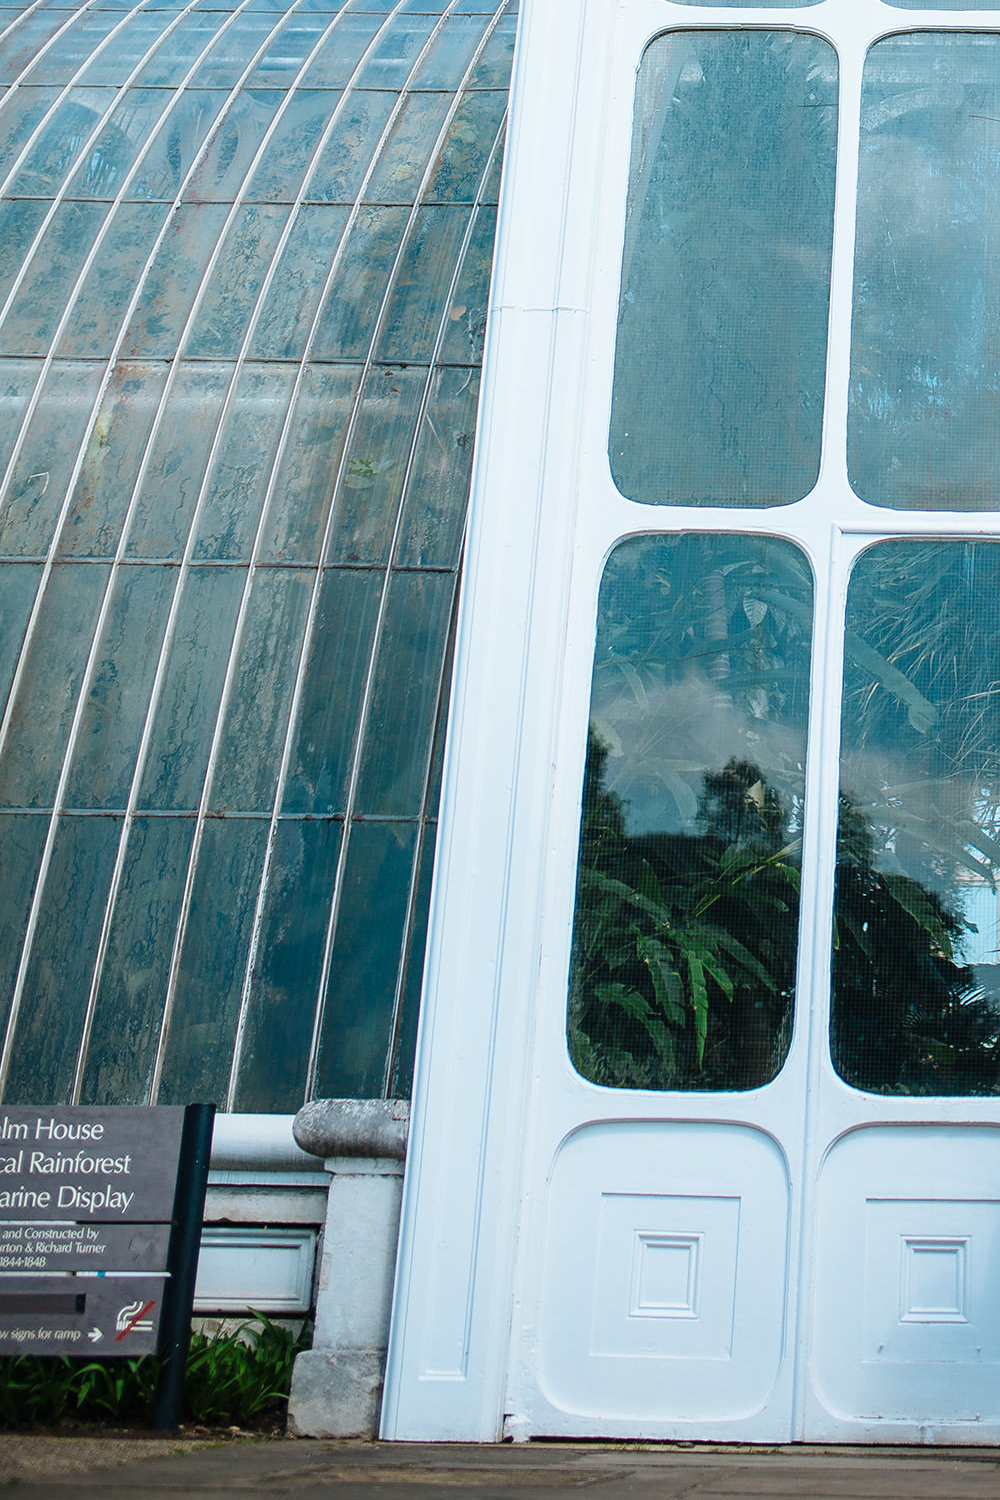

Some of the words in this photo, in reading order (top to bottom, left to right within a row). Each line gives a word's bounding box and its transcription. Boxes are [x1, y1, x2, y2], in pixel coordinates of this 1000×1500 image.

[0, 1116, 28, 1139] lm
[35, 1118, 104, 1140] House
[29, 1150, 131, 1174] Rainforest
[57, 1184, 134, 1213] Display
[2, 1227, 22, 1239] and
[24, 1227, 85, 1240] Constructed
[86, 1227, 100, 1242] by
[24, 1242, 34, 1253] &
[35, 1241, 73, 1253] Richard
[75, 1242, 106, 1253] Turner
[11, 1326, 36, 1342] signs
[38, 1326, 53, 1340] for
[54, 1330, 81, 1342] ramp
